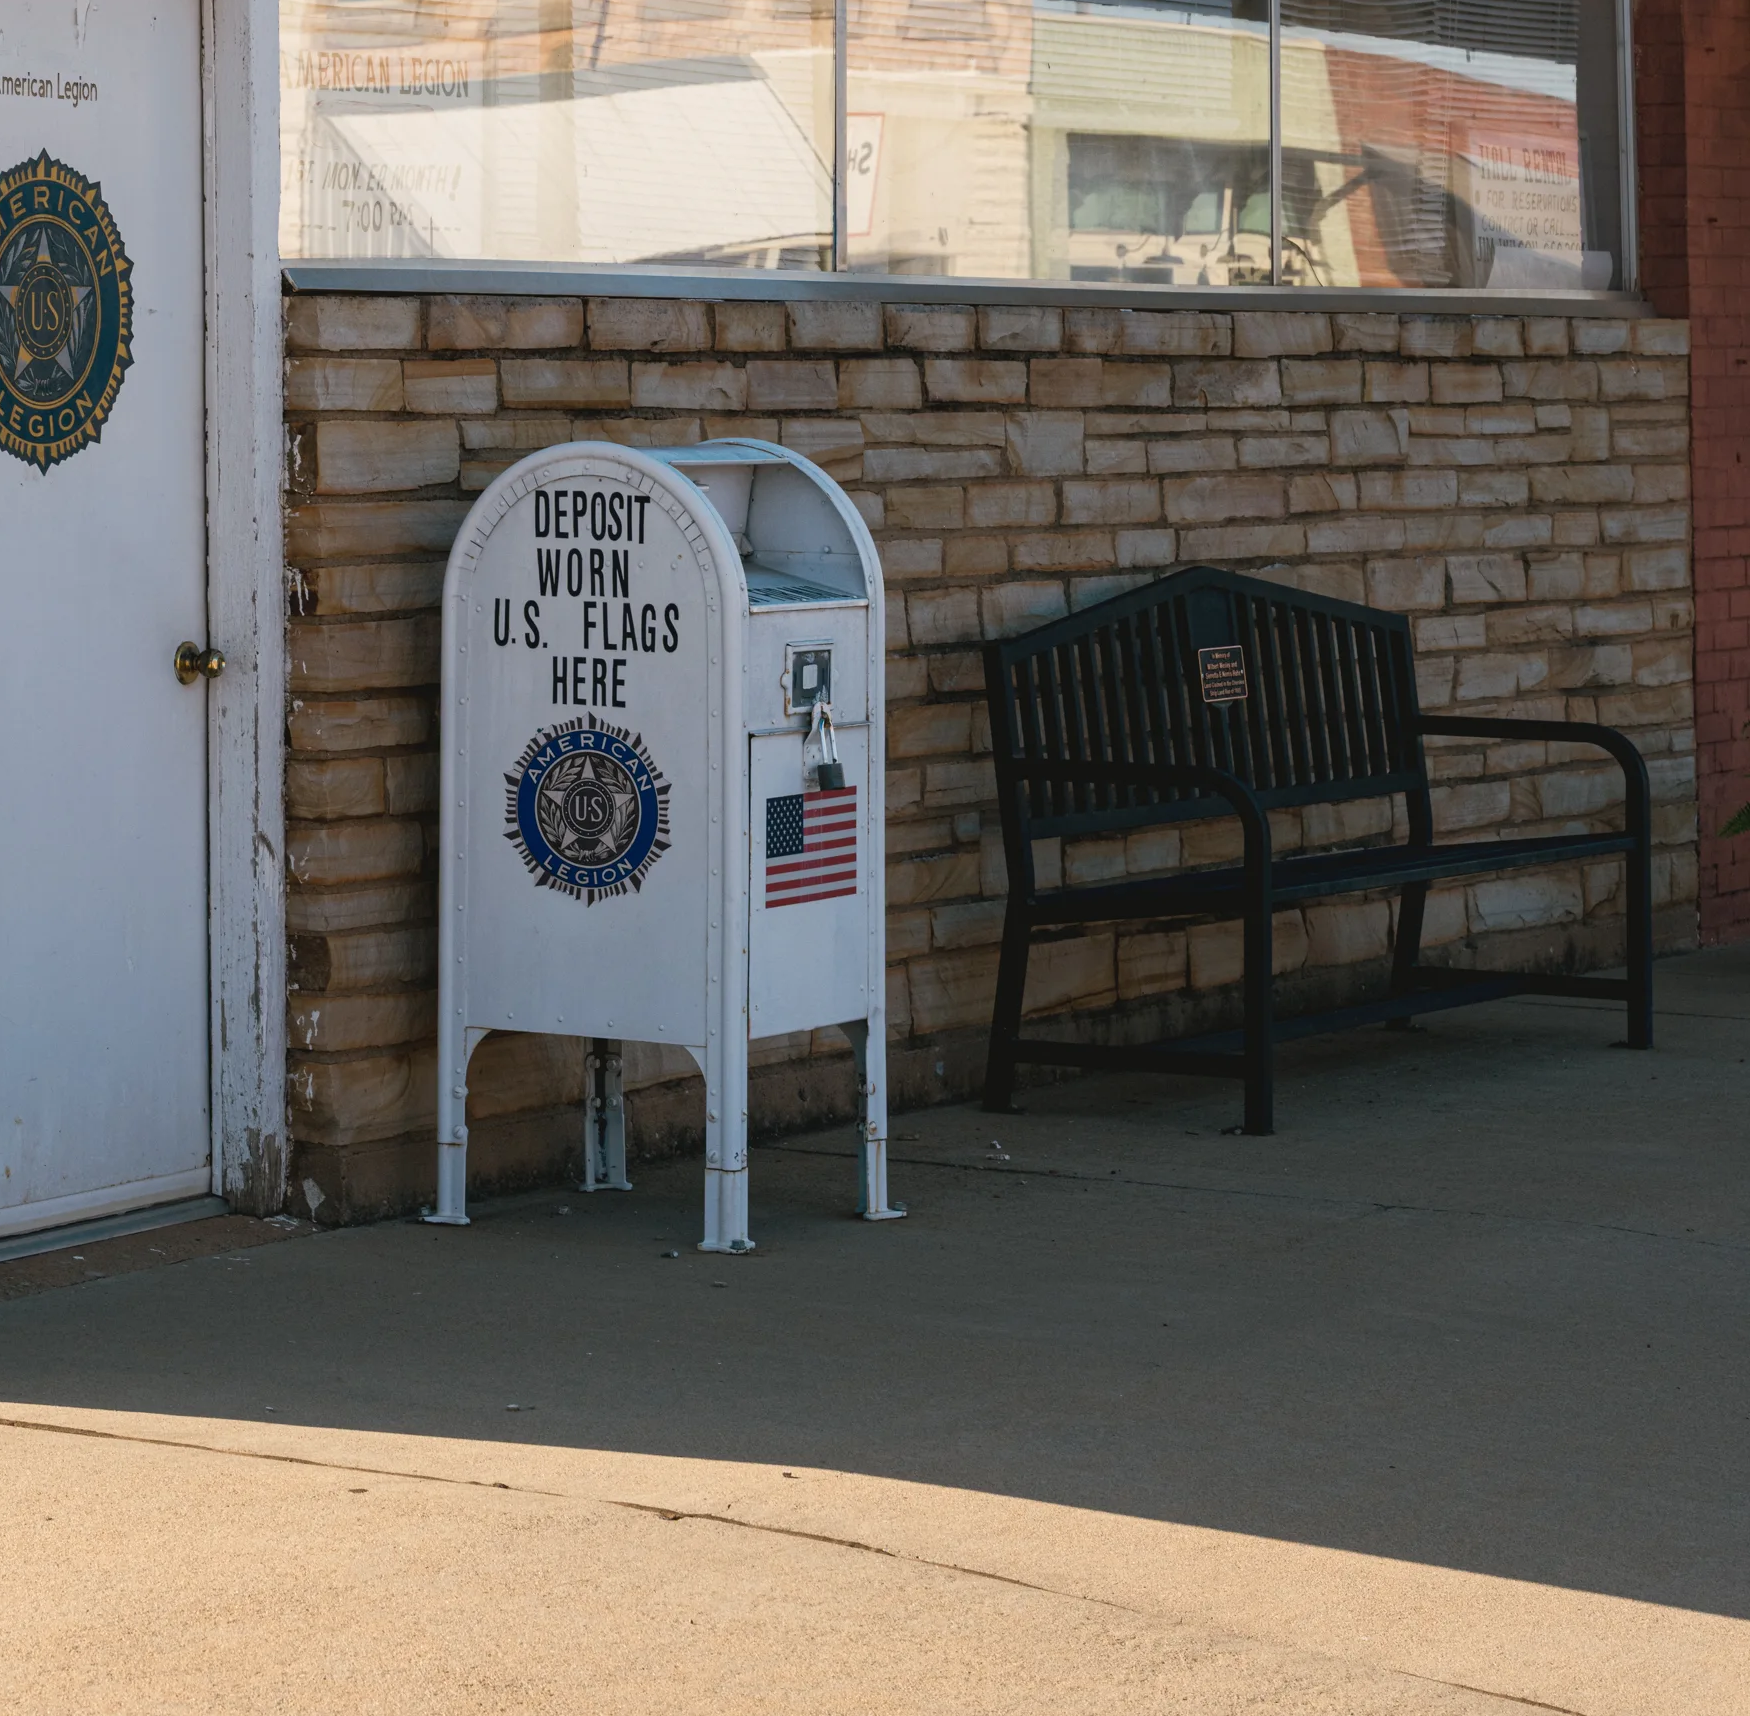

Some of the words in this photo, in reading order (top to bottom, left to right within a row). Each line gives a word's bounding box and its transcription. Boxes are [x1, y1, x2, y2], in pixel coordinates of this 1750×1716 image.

[56, 73, 98, 108] Legion
[399, 56, 469, 98] LEGION
[322, 161, 362, 191] MON.
[342, 199, 383, 233] 7:00
[1486, 189, 1505, 210] FOR
[1512, 190, 1577, 214] RESERVATIONS
[1527, 216, 1538, 237] OR
[534, 490, 651, 545] DEPOSIT
[537, 548, 629, 598] WORN
[494, 598, 548, 649] U.S.
[583, 602, 680, 653] FLAGS
[552, 655, 627, 709] HERE
[528, 733, 652, 792] AMERICAN
[543, 853, 633, 886] LEGION
